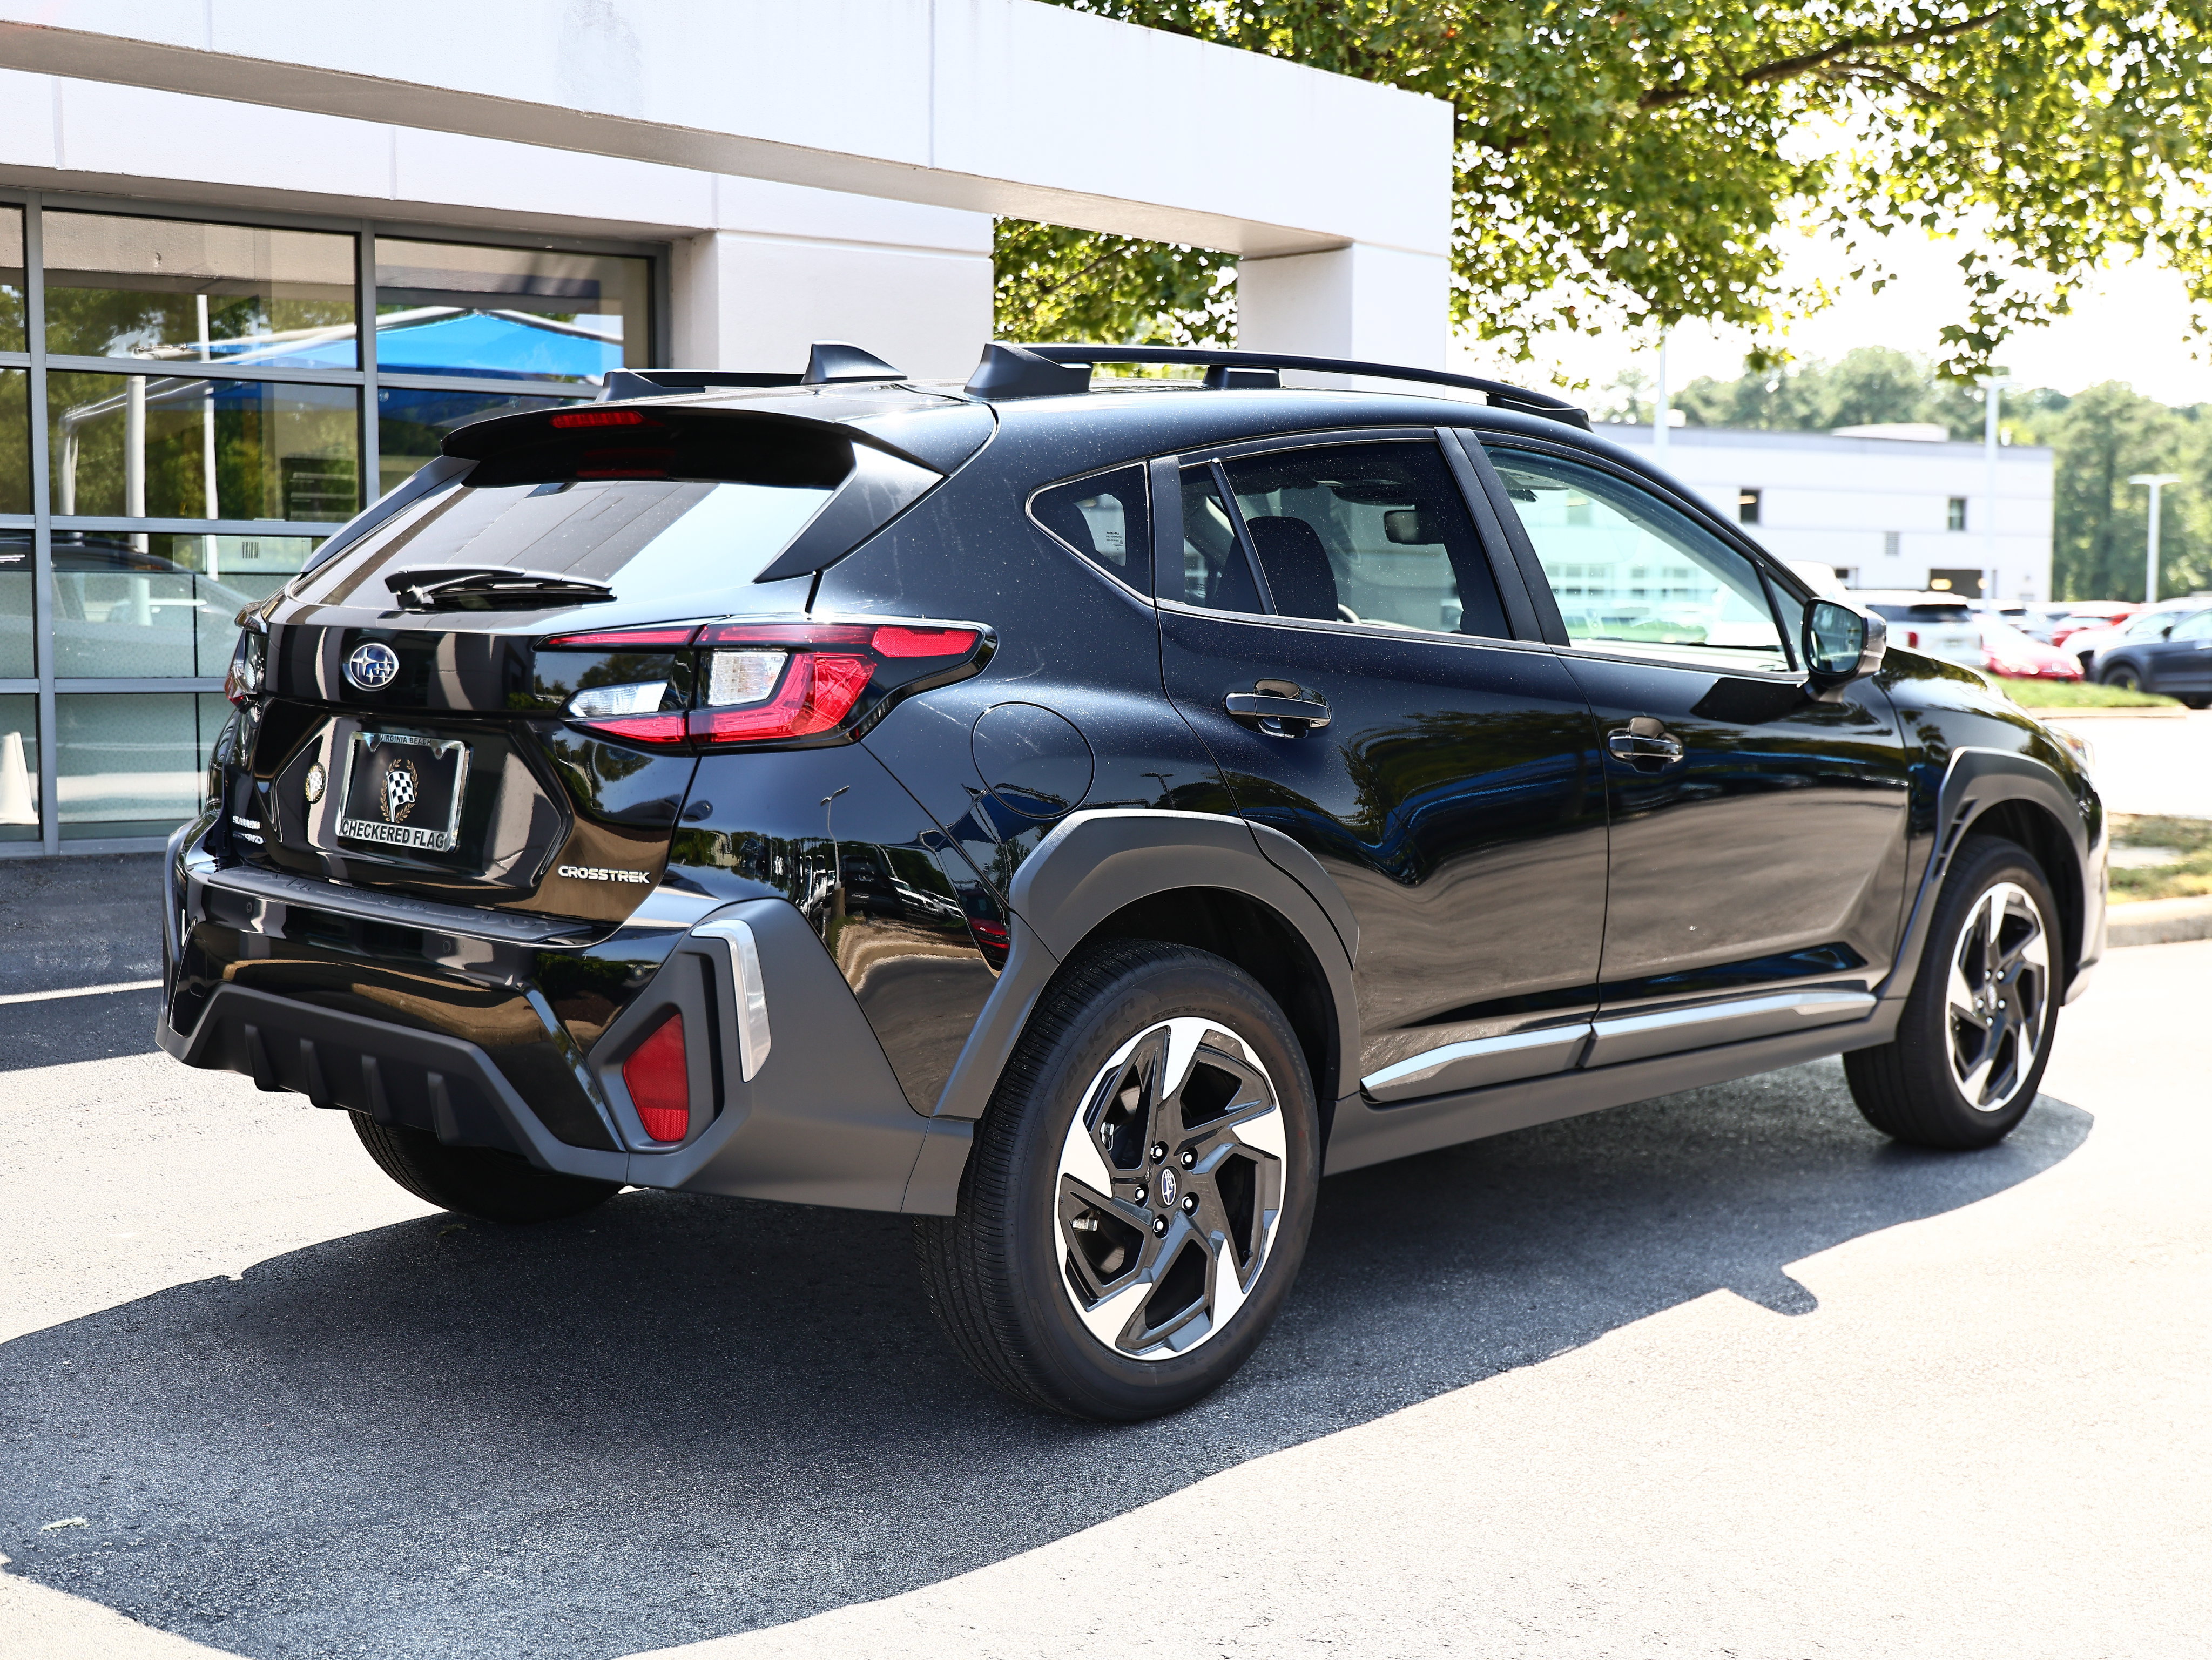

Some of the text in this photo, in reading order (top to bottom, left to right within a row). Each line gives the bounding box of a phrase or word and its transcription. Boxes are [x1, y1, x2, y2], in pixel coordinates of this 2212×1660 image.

[380, 734, 408, 743] VIRGINIA
[232, 815, 260, 830] SUBARU
[342, 820, 444, 849] CHECKERED FLAG
[558, 866, 650, 884] CROSSTREK
